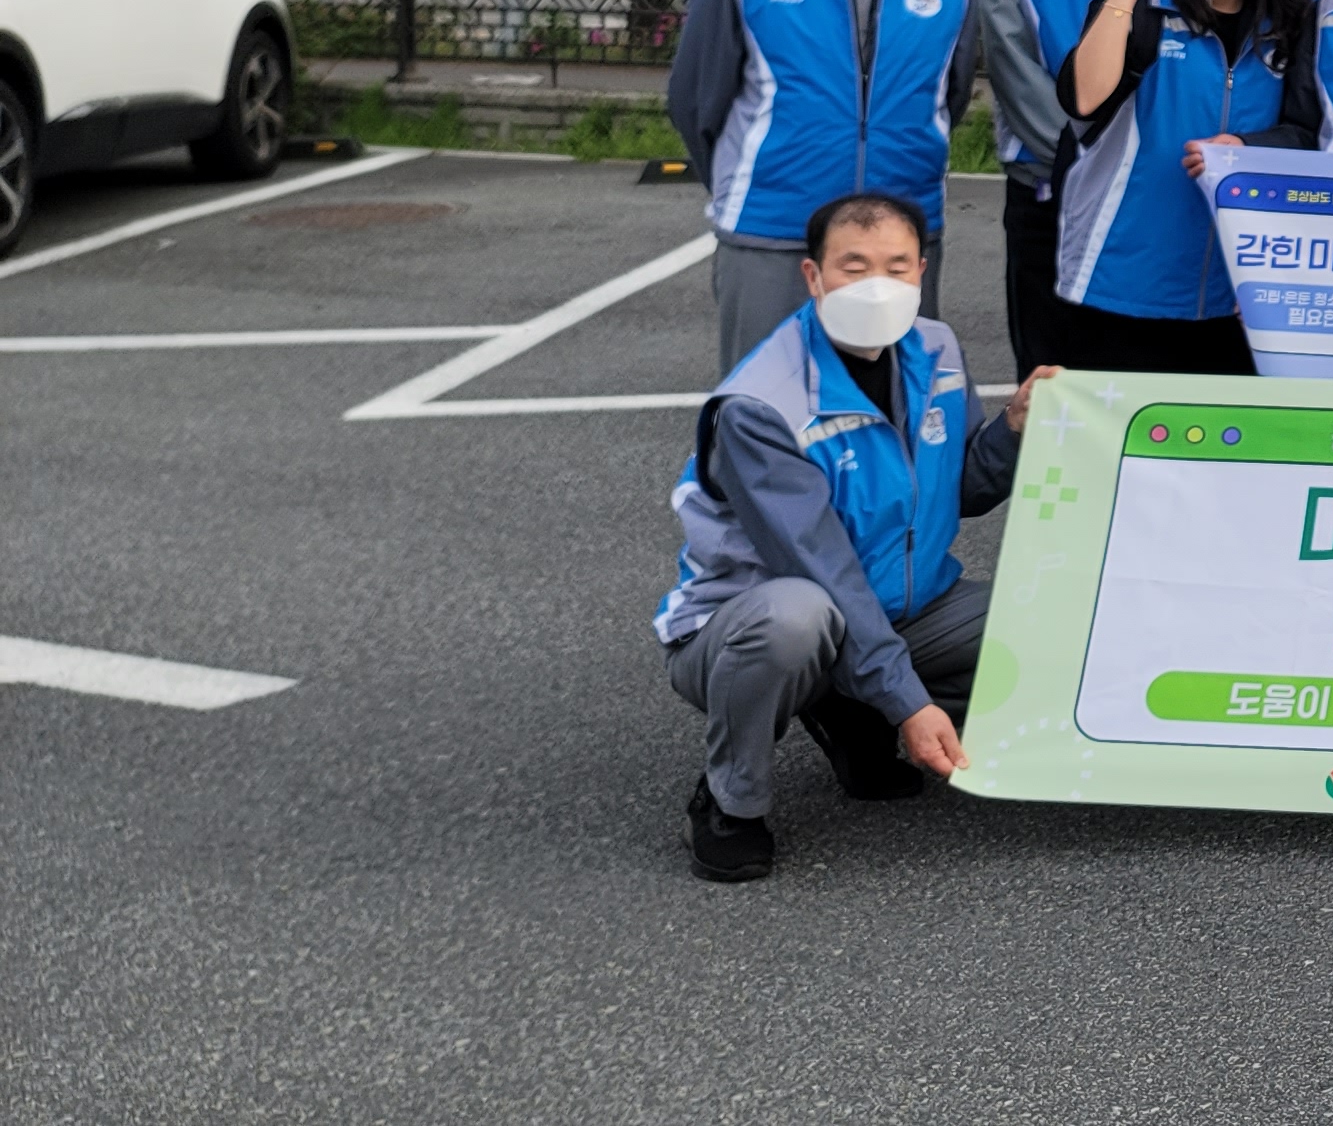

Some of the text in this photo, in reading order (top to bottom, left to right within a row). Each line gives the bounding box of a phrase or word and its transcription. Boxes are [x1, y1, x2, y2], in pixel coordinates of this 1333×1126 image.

[1287, 189, 1331, 204] 경상남도
[1236, 233, 1302, 269] 갇힌
[1226, 682, 1331, 720] 도움이
